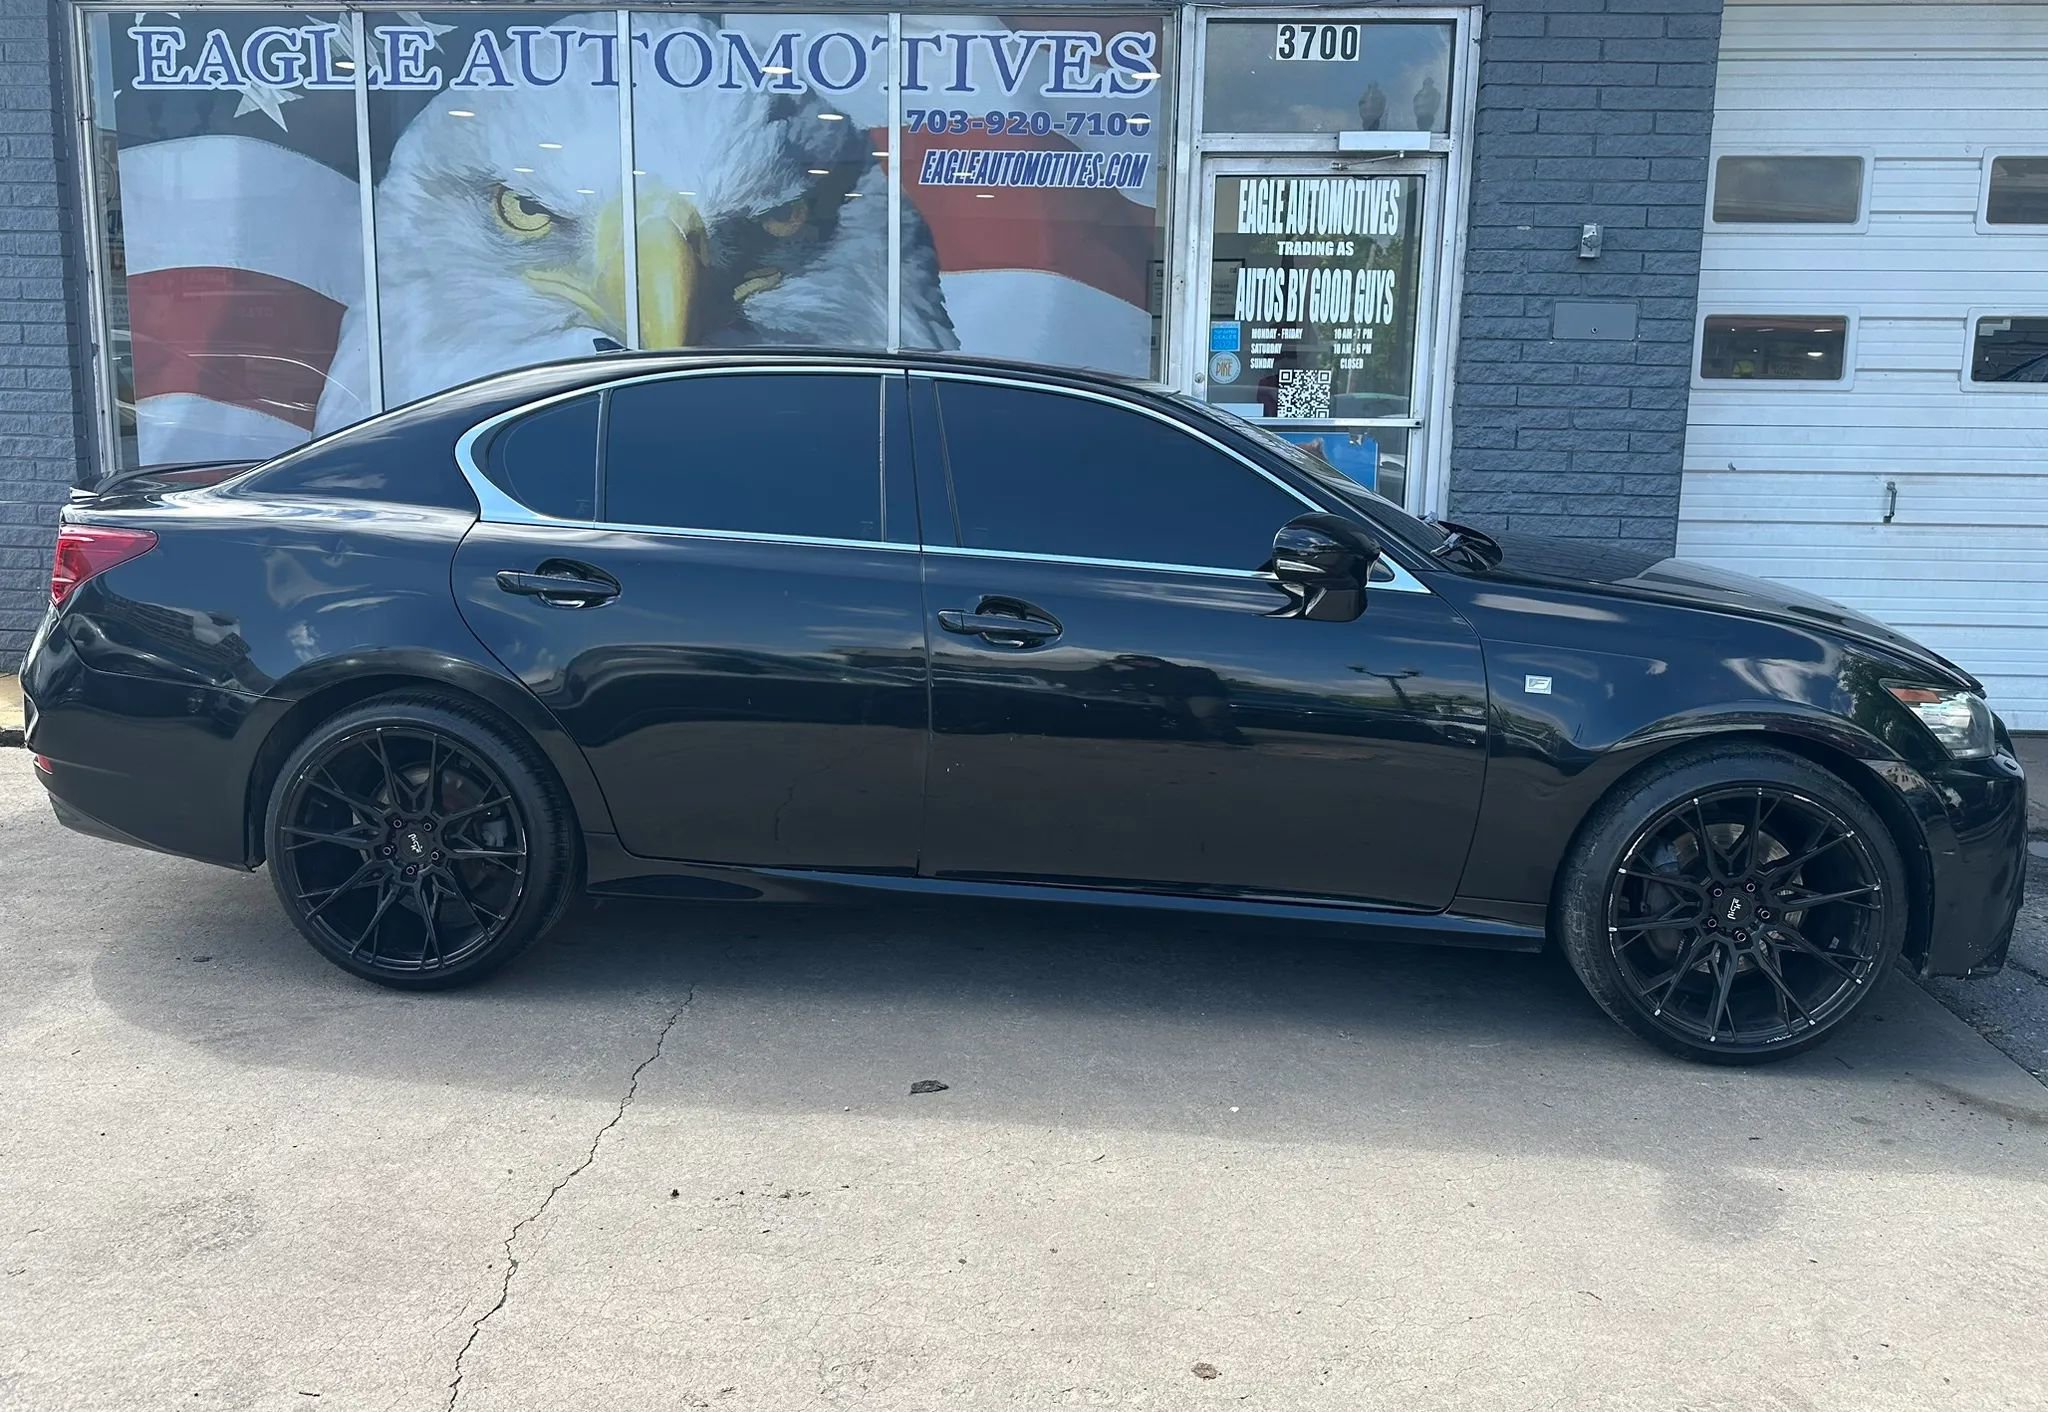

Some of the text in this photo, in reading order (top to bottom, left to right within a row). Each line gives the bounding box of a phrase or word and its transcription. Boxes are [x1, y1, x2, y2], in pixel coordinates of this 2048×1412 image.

[1278, 24, 1358, 60] 3700
[129, 26, 1157, 98] EAGLE AUTOMOTIVES
[906, 109, 1151, 137] 703-920-7100
[919, 149, 1151, 188] EAGLEAUTOMOTIVES.COM
[1237, 178, 1400, 235] EAGLE AUTOMOTIVES
[1277, 241, 1354, 256] TRADING AS
[1234, 267, 1285, 322] AUTOS
[1286, 268, 1309, 323] BY
[1309, 268, 1352, 324] GOOD
[1354, 269, 1395, 325] GUYS
[1250, 343, 1282, 354] SATURDAY
[1333, 343, 1341, 354] 10
[1341, 343, 1352, 354] AM
[1361, 343, 1372, 354] PM
[1251, 328, 1277, 339] MONDAY
[1281, 328, 1303, 339] FRIDAY
[1334, 328, 1342, 339] 10
[1342, 328, 1353, 339] AM
[1357, 328, 1361, 339] 7
[1362, 328, 1373, 339] PM
[1250, 358, 1364, 369] SUNDAY CLOSED
